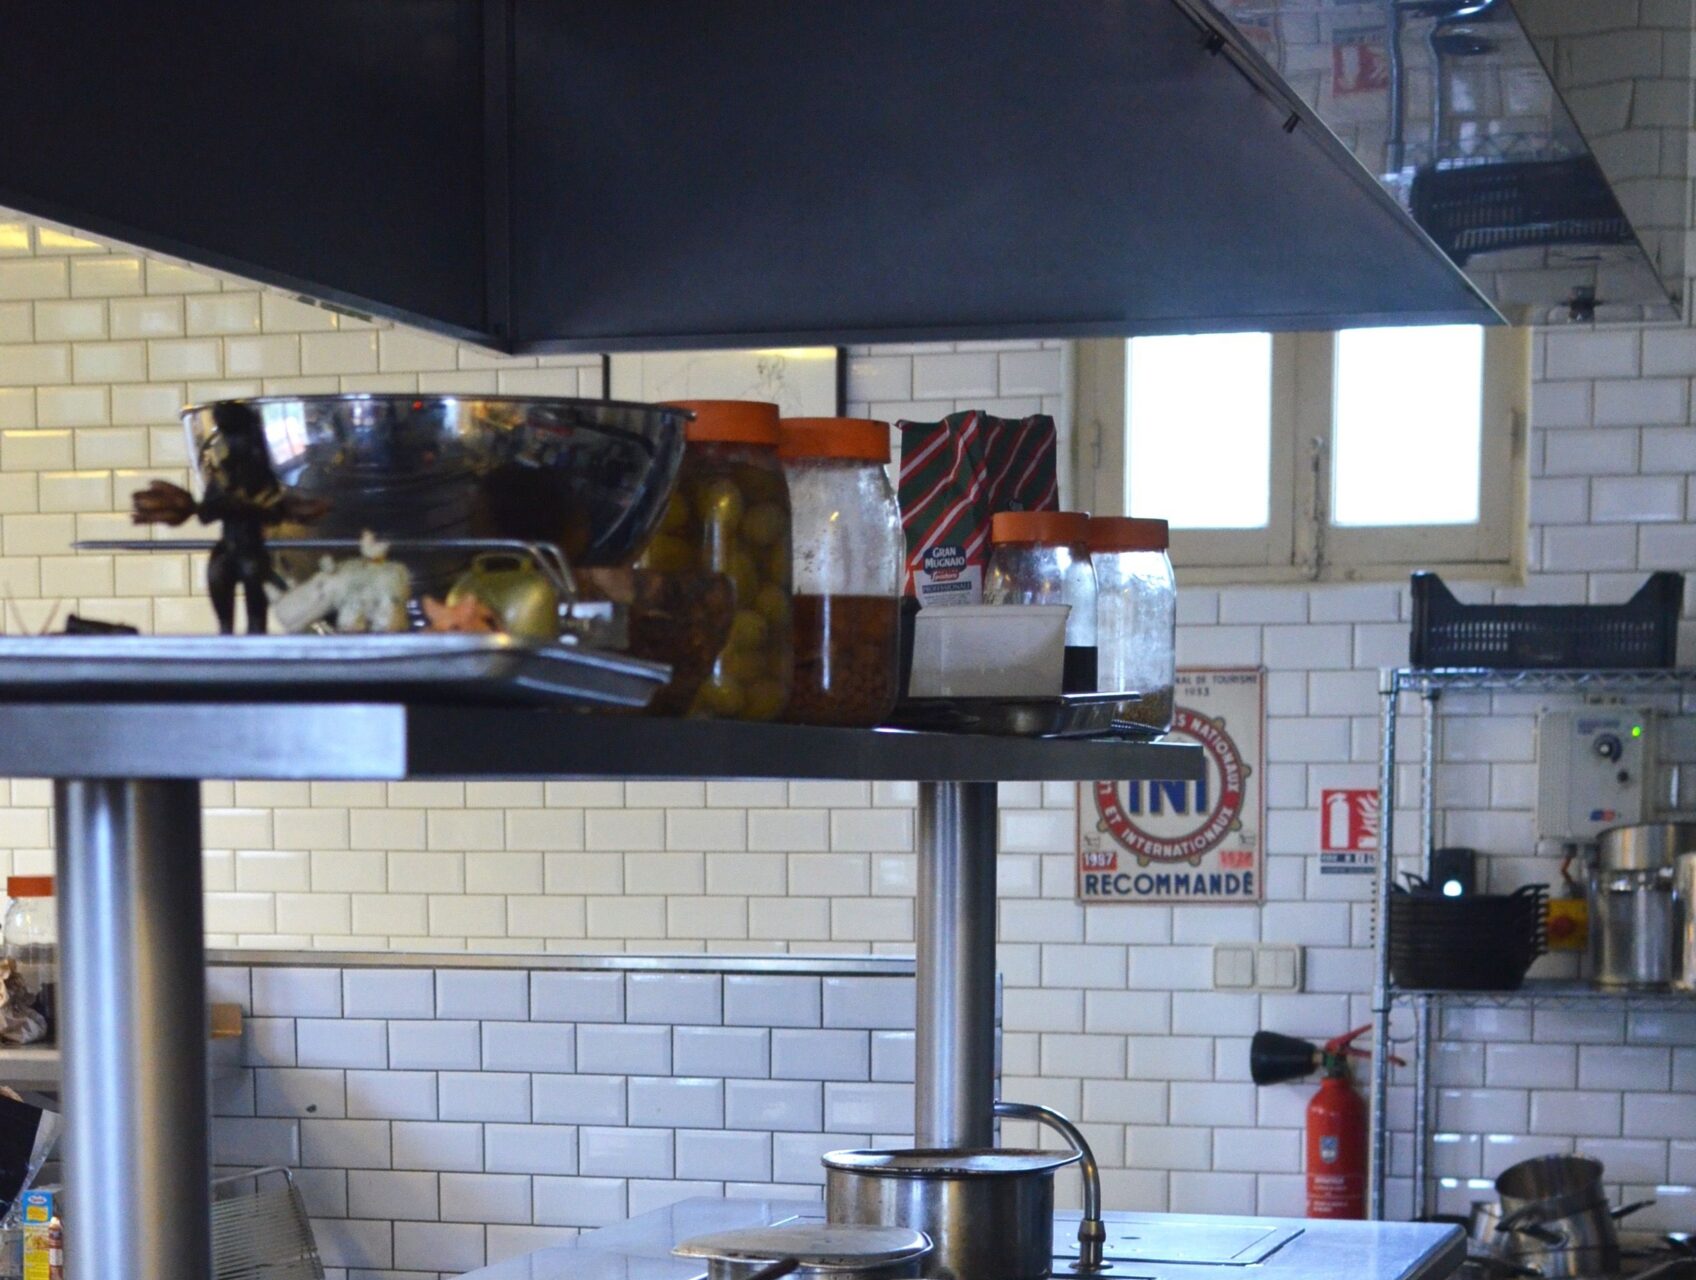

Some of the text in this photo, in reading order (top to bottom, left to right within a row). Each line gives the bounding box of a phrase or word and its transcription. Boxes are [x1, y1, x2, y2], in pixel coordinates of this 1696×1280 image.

[924, 557, 965, 569] MUGNAIO
[932, 546, 957, 558] GRAN
[1191, 716, 1240, 793] NATIONAUX
[1105, 806, 1235, 858] ET INTERNATIONAUX
[1085, 870, 1254, 896] RECOMMANDÉ
